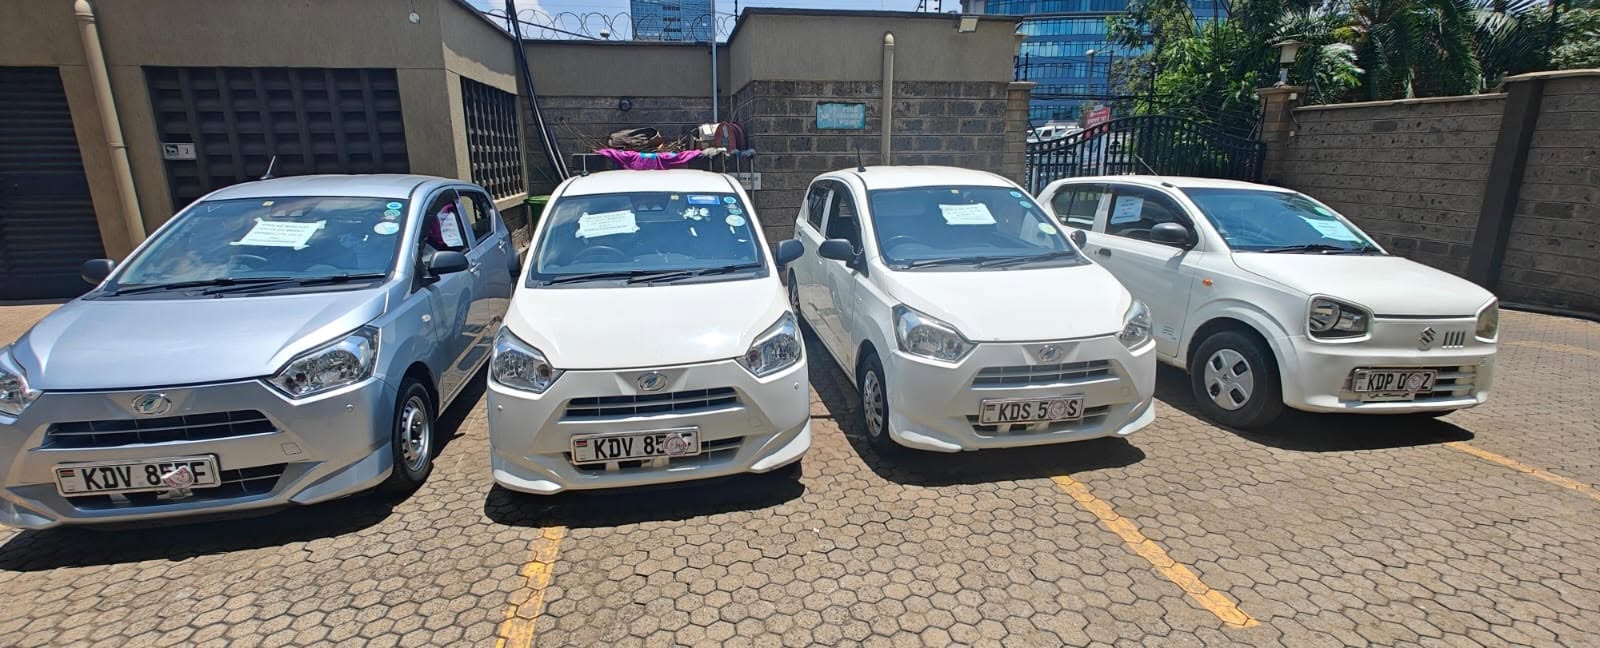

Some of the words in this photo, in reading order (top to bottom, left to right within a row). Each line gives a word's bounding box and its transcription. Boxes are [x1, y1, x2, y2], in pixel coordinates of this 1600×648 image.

[1367, 373, 1393, 390] KDP
[1397, 373, 1431, 390] 0Z
[999, 403, 1031, 421] KDS
[1038, 400, 1077, 419] 5S
[594, 437, 633, 459] KDV
[643, 432, 692, 455] 85
[81, 466, 131, 490] KDV
